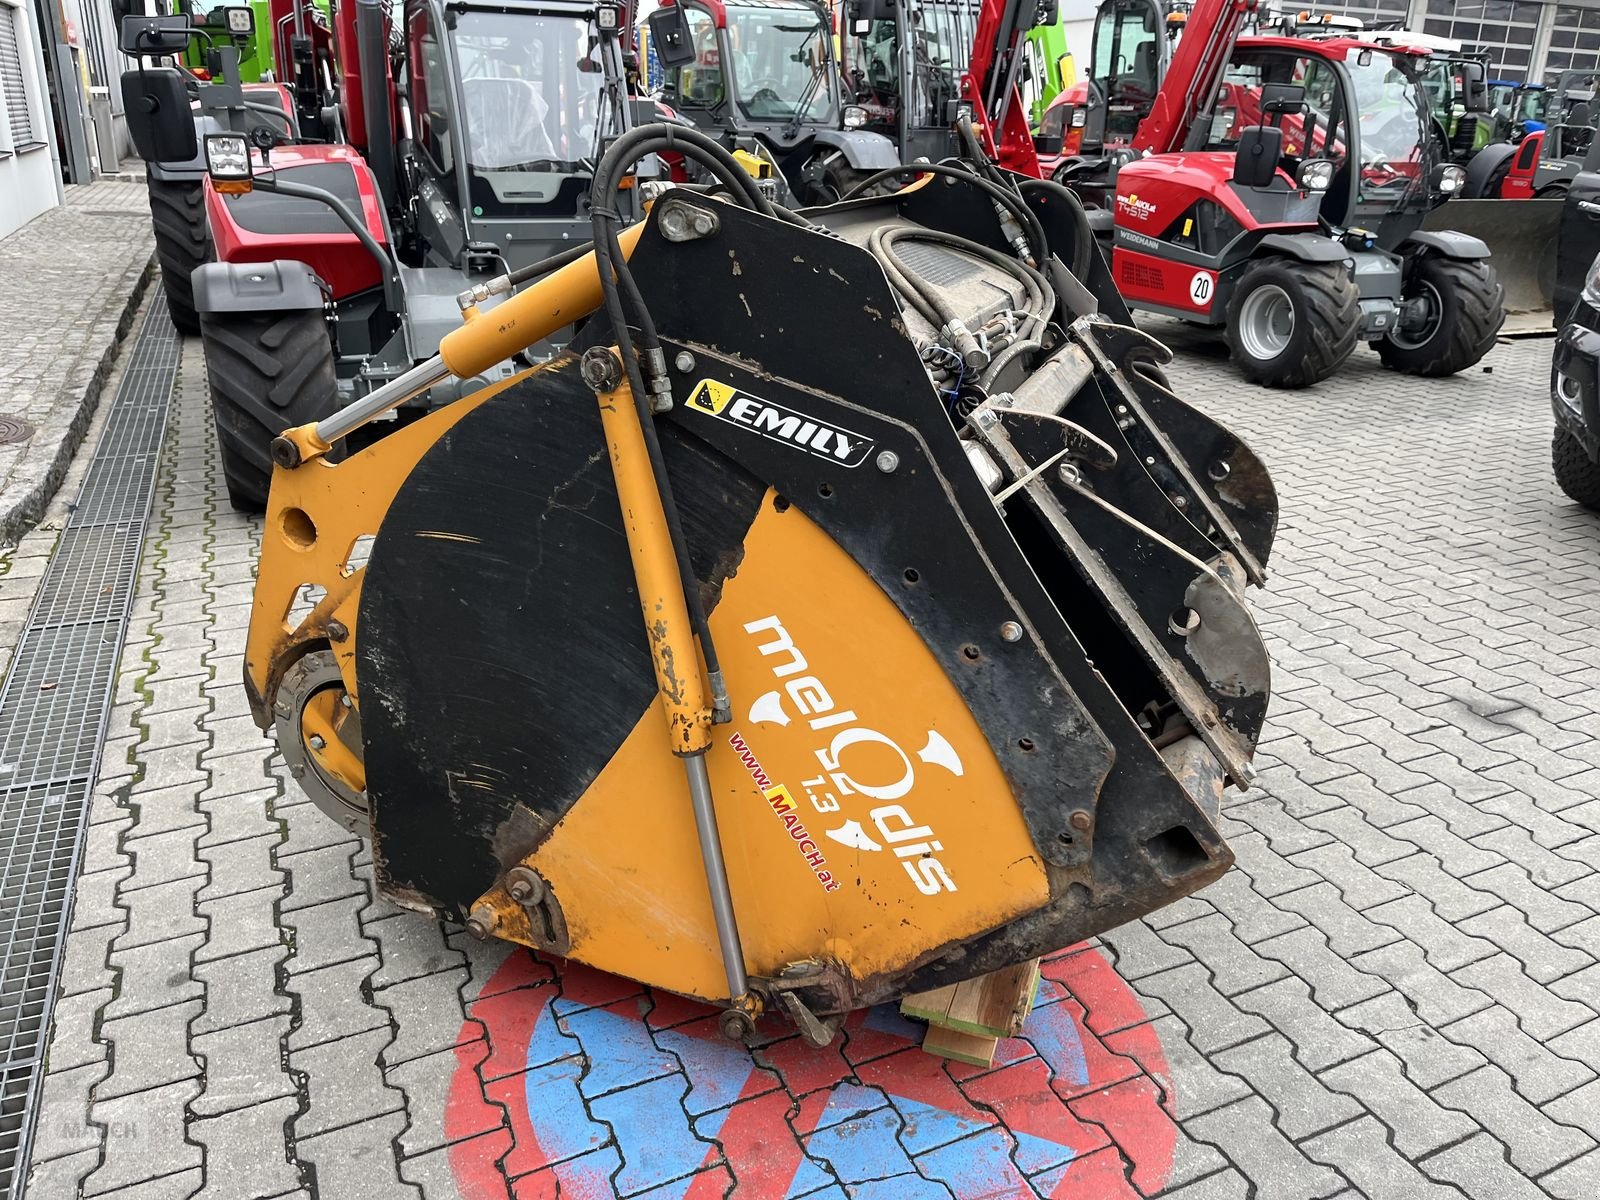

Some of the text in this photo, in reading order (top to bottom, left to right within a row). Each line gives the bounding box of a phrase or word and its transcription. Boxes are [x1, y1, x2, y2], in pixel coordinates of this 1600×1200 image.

[1118, 202, 1149, 221] T4512
[1120, 229, 1160, 250] WEIDEMANN
[1194, 277, 1209, 299] 20
[728, 397, 862, 460] EMILY
[801, 773, 841, 814] 1.3
